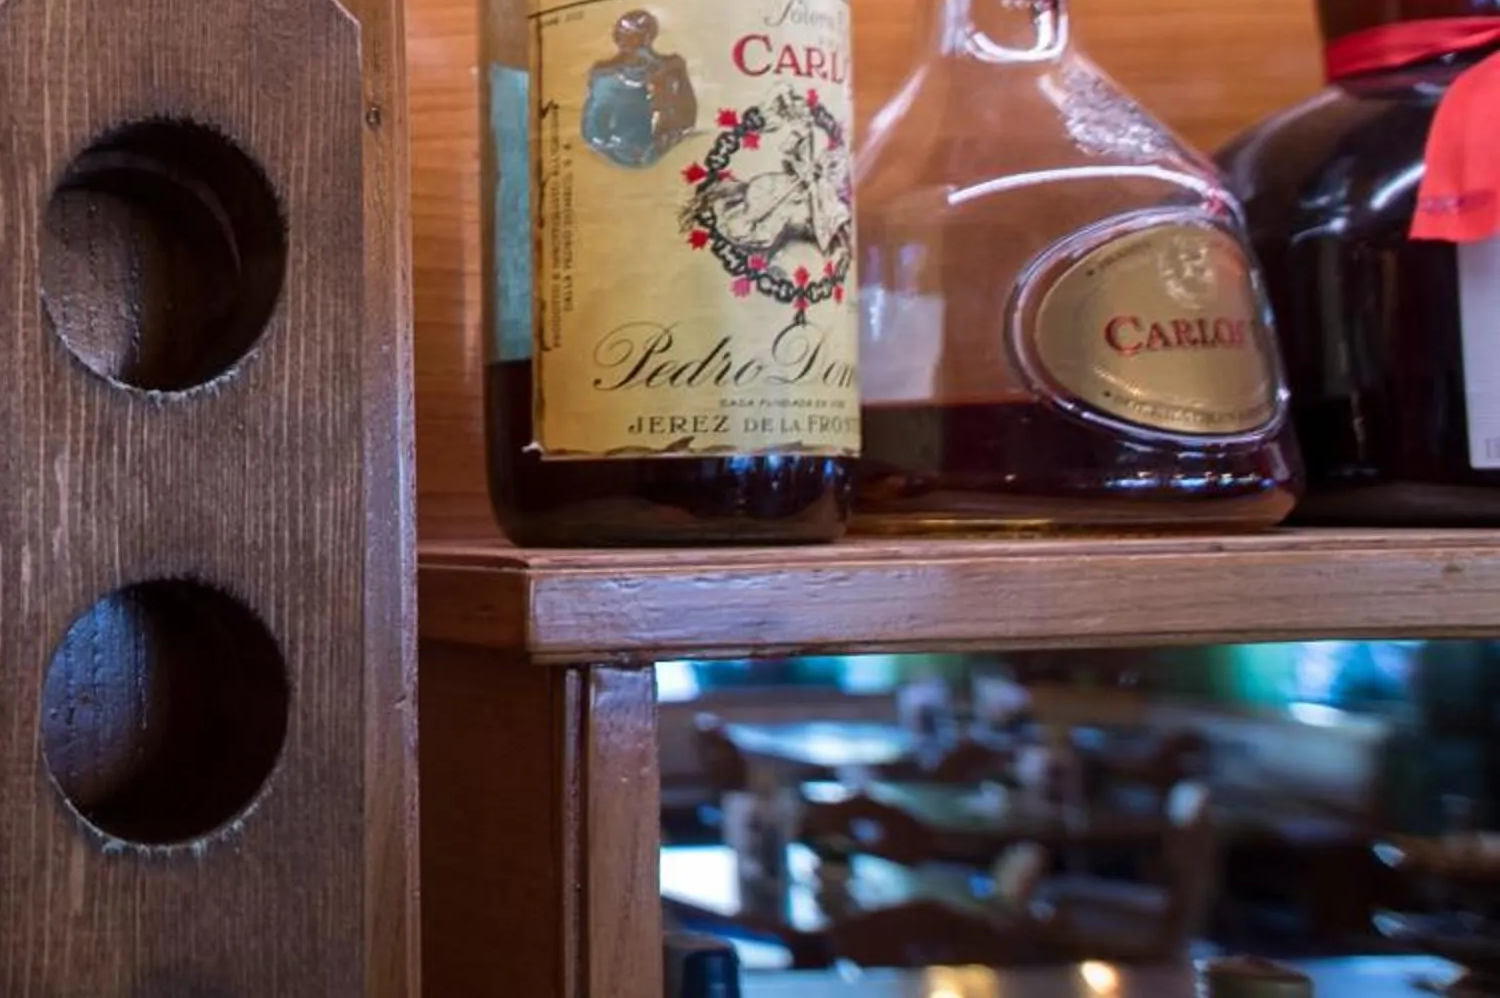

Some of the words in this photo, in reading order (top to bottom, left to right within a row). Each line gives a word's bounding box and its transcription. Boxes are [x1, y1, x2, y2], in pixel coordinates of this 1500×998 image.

[592, 320, 763, 391] Pedro
[627, 415, 729, 434] JEREZ
[743, 416, 774, 433] DE
[780, 417, 801, 433] LA
